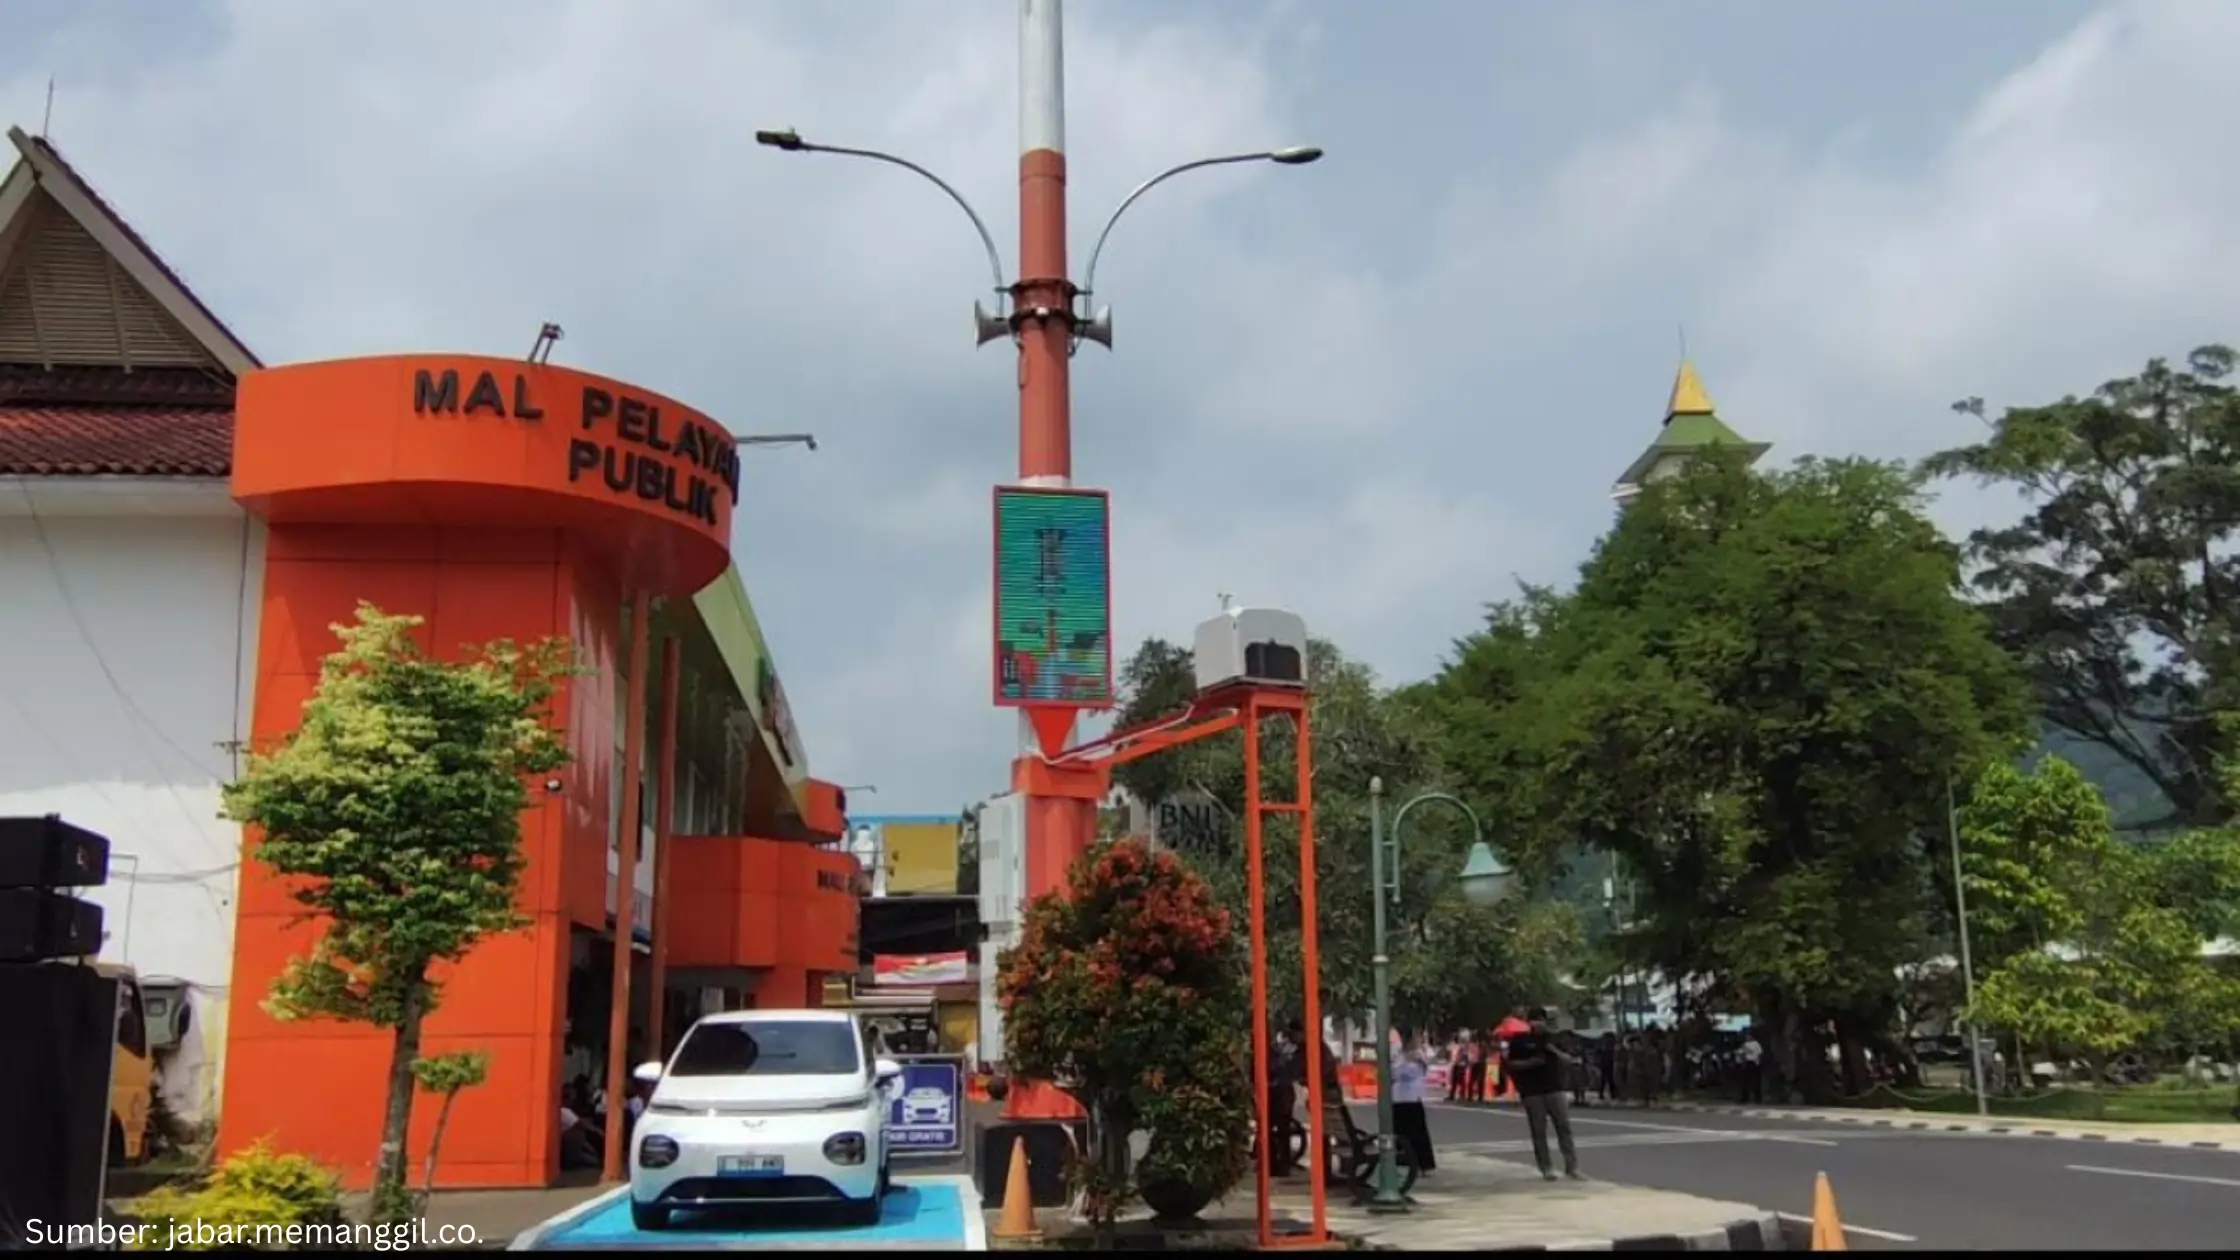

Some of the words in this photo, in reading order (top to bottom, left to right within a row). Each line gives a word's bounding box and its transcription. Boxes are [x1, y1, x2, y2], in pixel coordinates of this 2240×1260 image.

[414, 369, 543, 419] MAL
[568, 438, 717, 526] PUBLIK
[1160, 803, 1211, 829] BNI
